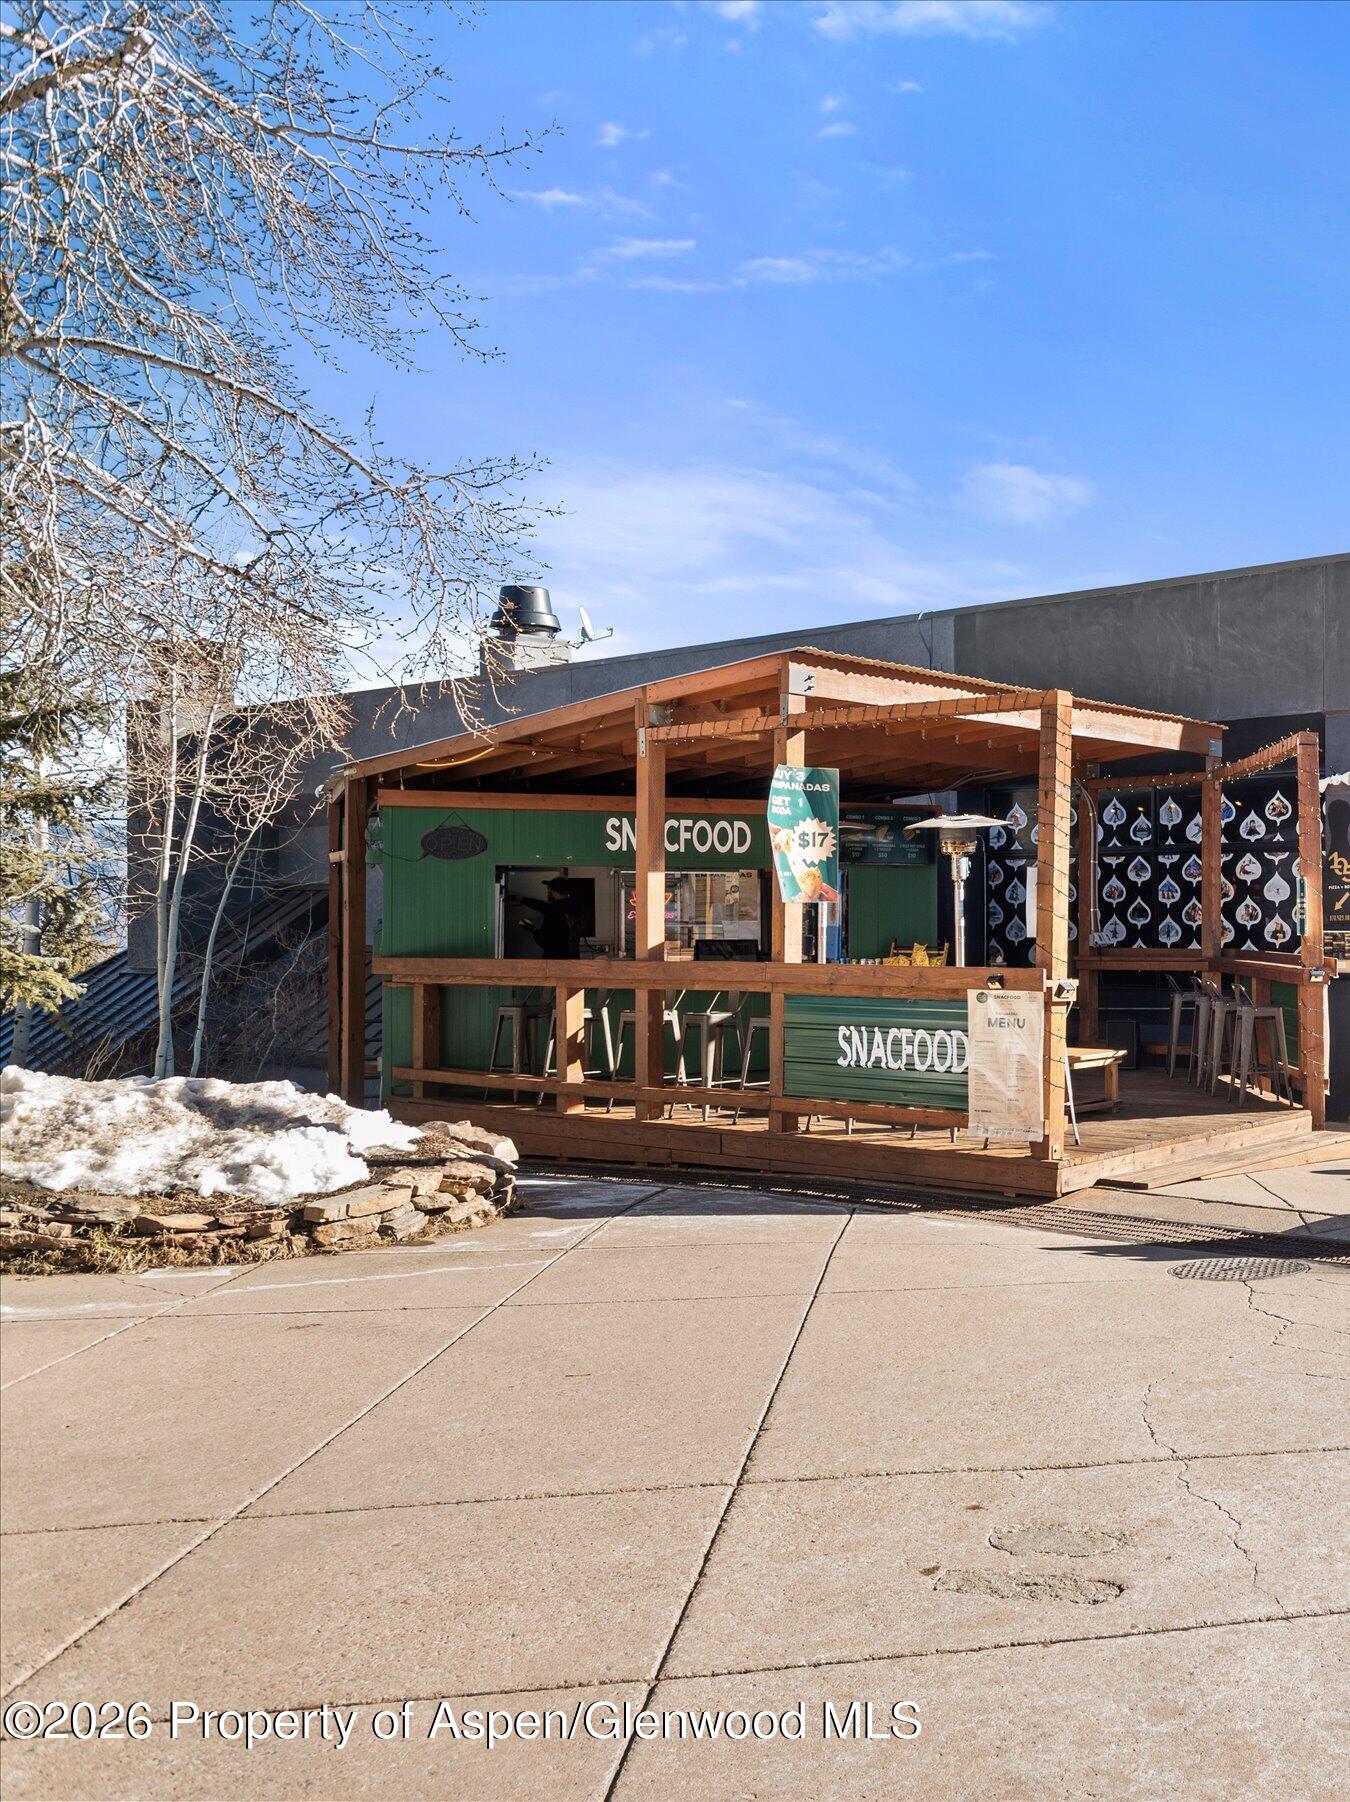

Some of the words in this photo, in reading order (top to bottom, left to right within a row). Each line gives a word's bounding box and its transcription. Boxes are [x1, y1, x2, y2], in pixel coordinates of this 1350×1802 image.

[605, 817, 752, 854] SNCFOOD
[798, 831, 830, 849] $17
[987, 1017, 1026, 1029] MENU
[837, 1025, 969, 1073] SNACFOOD
